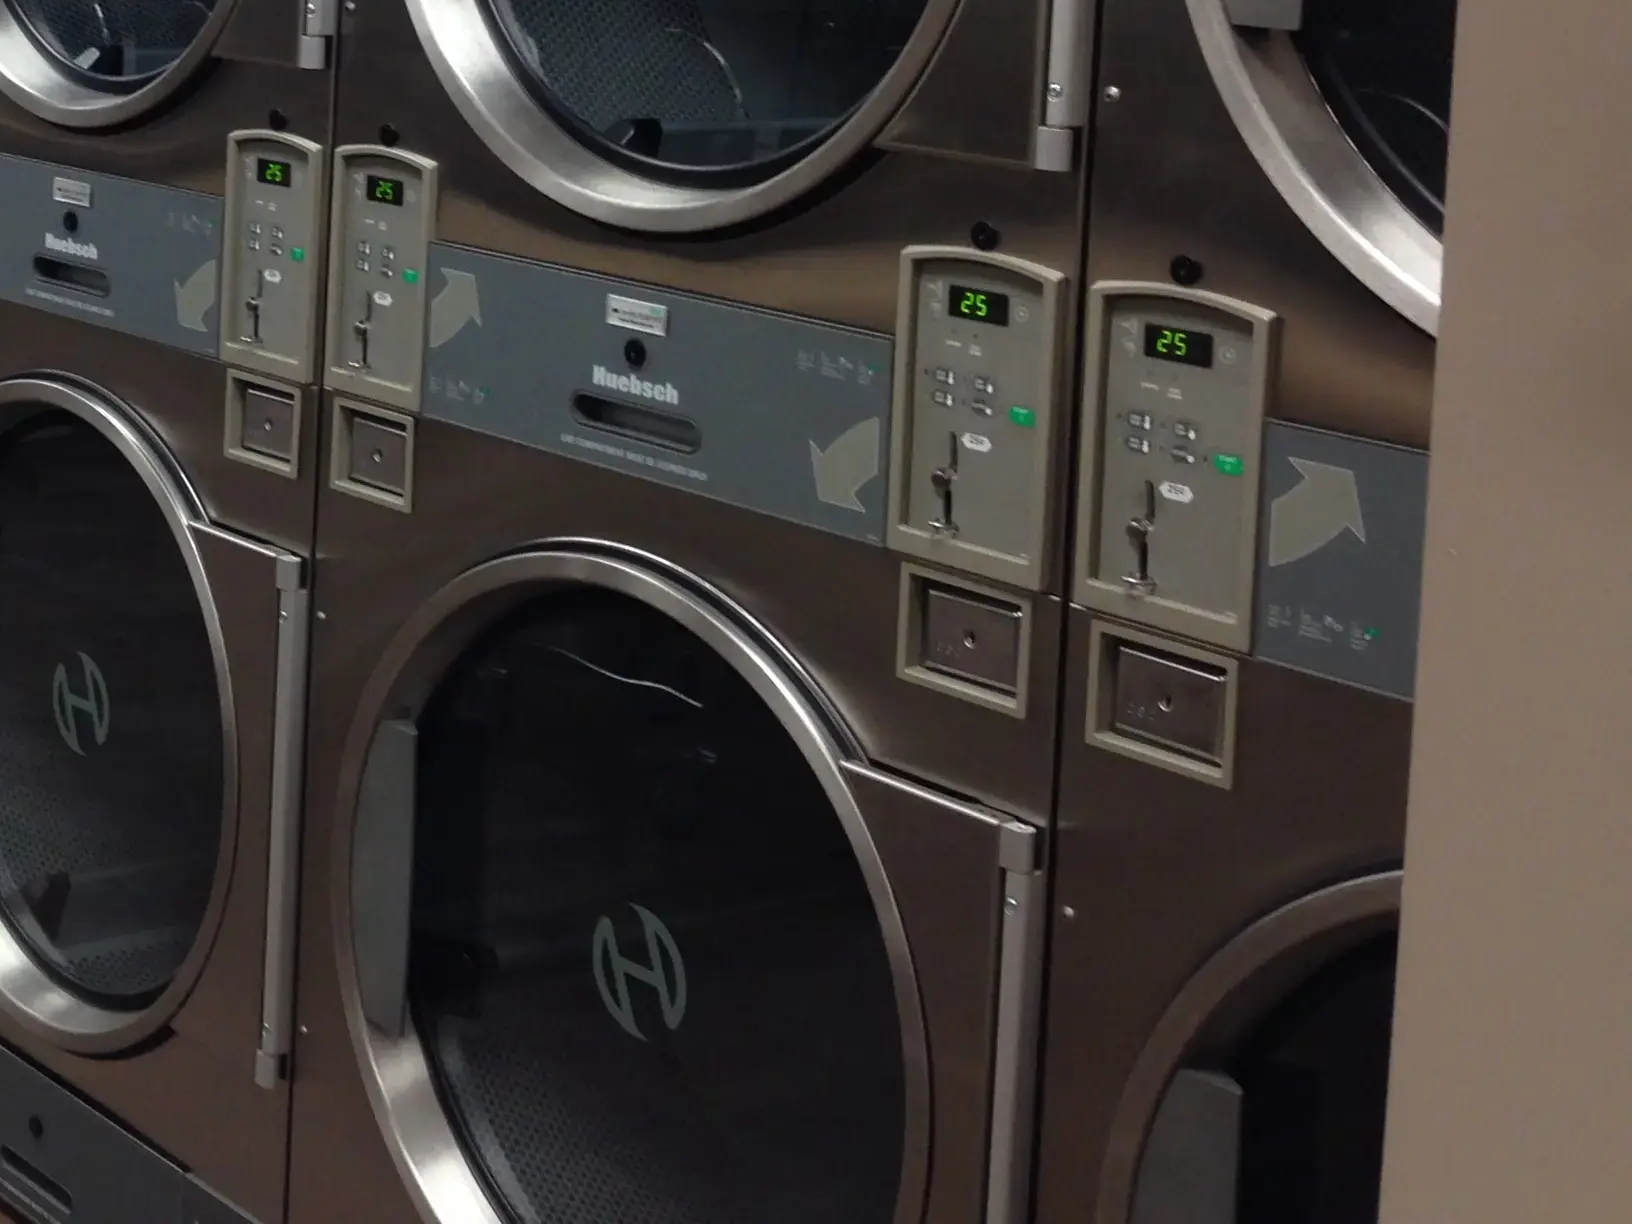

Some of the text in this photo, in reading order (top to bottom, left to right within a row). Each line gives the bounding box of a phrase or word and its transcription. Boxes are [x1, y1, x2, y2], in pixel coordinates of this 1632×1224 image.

[960, 291, 987, 317] 25
[1156, 329, 1187, 356] 25
[592, 364, 679, 405] Huebsch
[52, 650, 111, 757] H
[592, 902, 687, 1042] H
